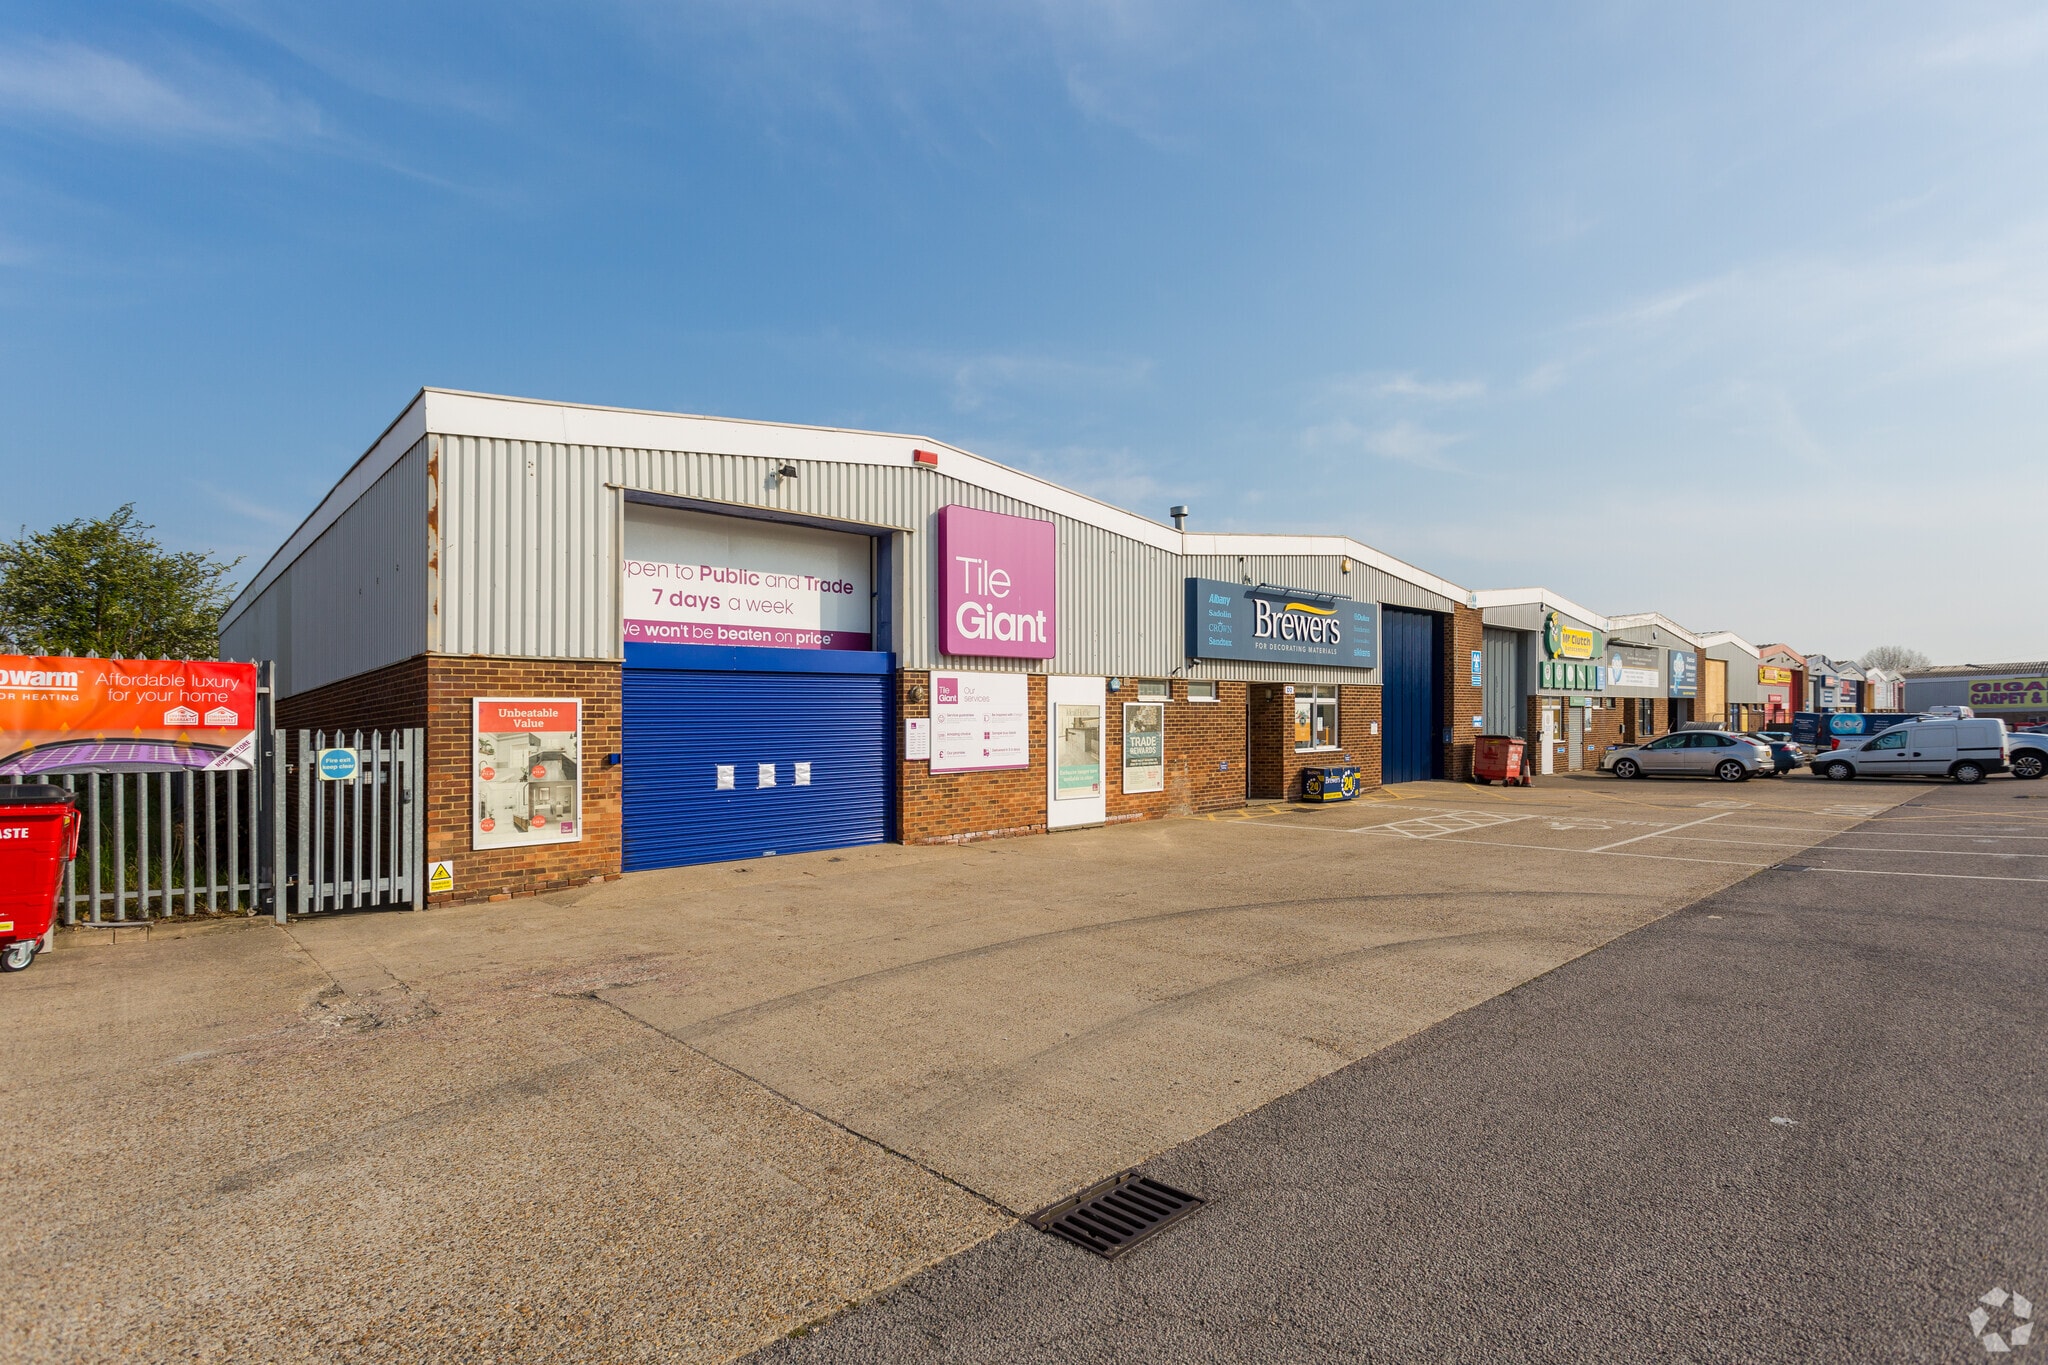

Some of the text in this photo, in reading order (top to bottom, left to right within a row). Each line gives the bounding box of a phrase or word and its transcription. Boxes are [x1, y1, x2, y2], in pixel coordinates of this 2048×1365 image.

[675, 563, 694, 580] to
[700, 565, 760, 586] Public
[765, 575, 800, 590] and
[804, 575, 854, 595] Trade
[956, 556, 1011, 598] Tile
[652, 588, 794, 615] 7 days a week
[956, 601, 1046, 643] Giant
[1253, 599, 1341, 645] Brewers
[644, 624, 689, 638] won't
[692, 625, 713, 639] be
[717, 626, 771, 642] beaten
[775, 632, 793, 642] on
[1572, 634, 1591, 646] Clutch
[1255, 642, 1337, 655] FOR DECORATING MATERIALS
[95, 672, 240, 691] Affordable luxury
[938, 686, 950, 694] Tile
[963, 687, 975, 695] Our
[22, 693, 79, 701] HEATING
[107, 688, 229, 705] for your home
[938, 694, 957, 702] Giant
[963, 695, 990, 703] services
[1970, 691, 2043, 705] CARPET &
[498, 708, 559, 718] Unbeatable
[513, 719, 544, 728] Value
[1129, 736, 1157, 747] TRADE
[214, 755, 229, 767] NOW
[234, 740, 251, 755] STORE
[1129, 747, 1157, 755] REWARDS
[1310, 782, 1319, 791] 24
[1344, 776, 1353, 791] 24
[0, 828, 29, 838] STE
